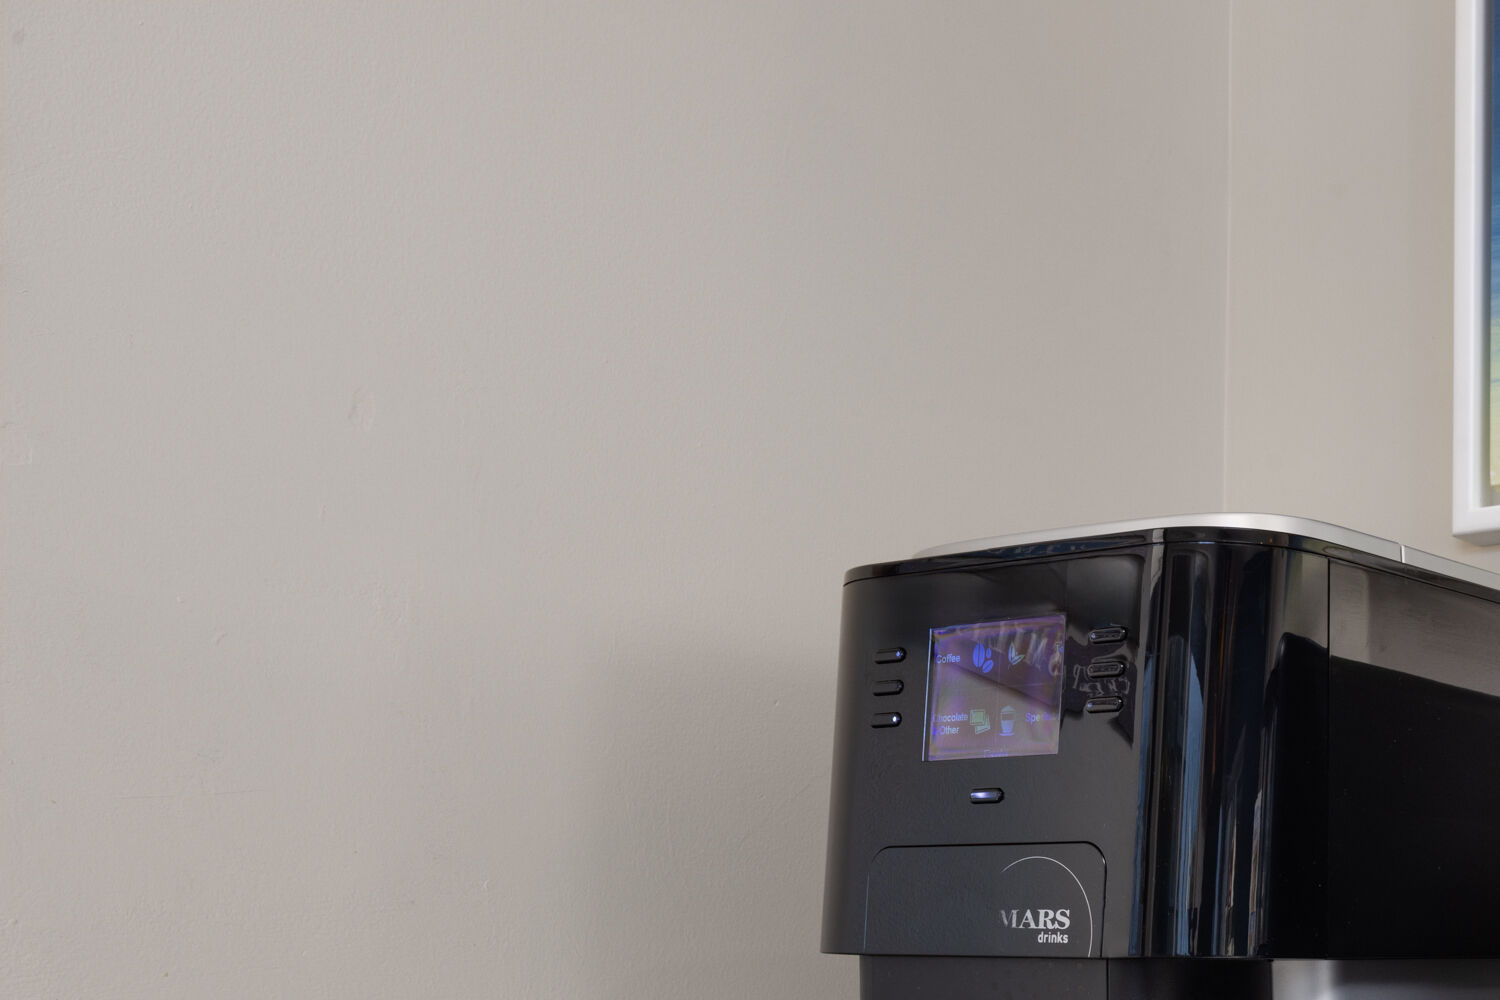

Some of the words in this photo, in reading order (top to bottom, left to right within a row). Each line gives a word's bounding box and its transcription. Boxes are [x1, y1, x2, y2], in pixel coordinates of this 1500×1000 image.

[936, 653, 961, 664] Coffee
[1000, 908, 1071, 930] MARS
[1037, 931, 1069, 943] drinks
